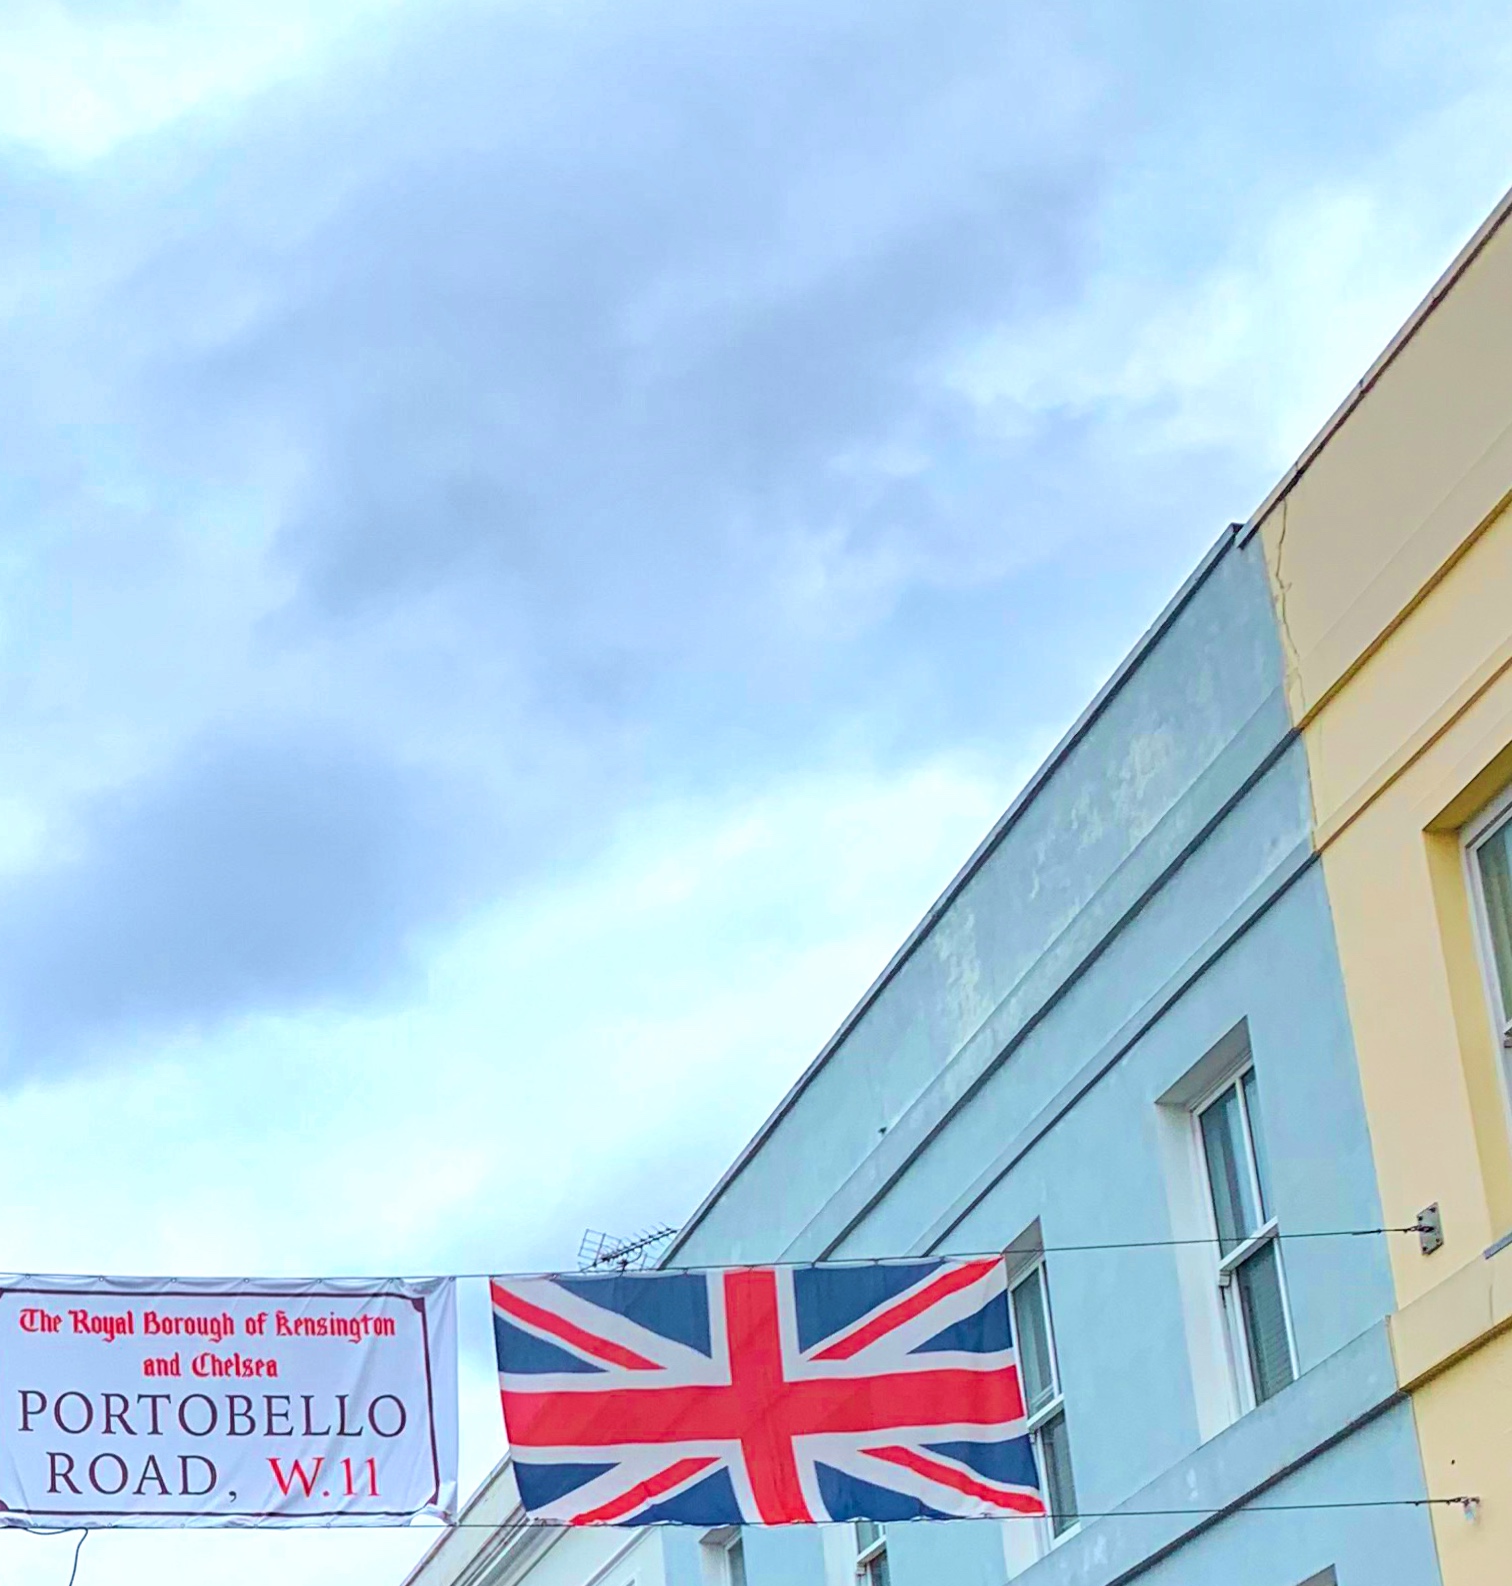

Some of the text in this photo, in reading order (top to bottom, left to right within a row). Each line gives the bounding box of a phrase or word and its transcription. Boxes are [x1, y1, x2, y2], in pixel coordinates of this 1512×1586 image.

[19, 1308, 396, 1344] The Royal Borough of Kensington
[143, 1352, 278, 1378] and Chelsea
[18, 1389, 408, 1438] PORTOBELLO
[46, 1451, 380, 1503] ROAD, W.11
